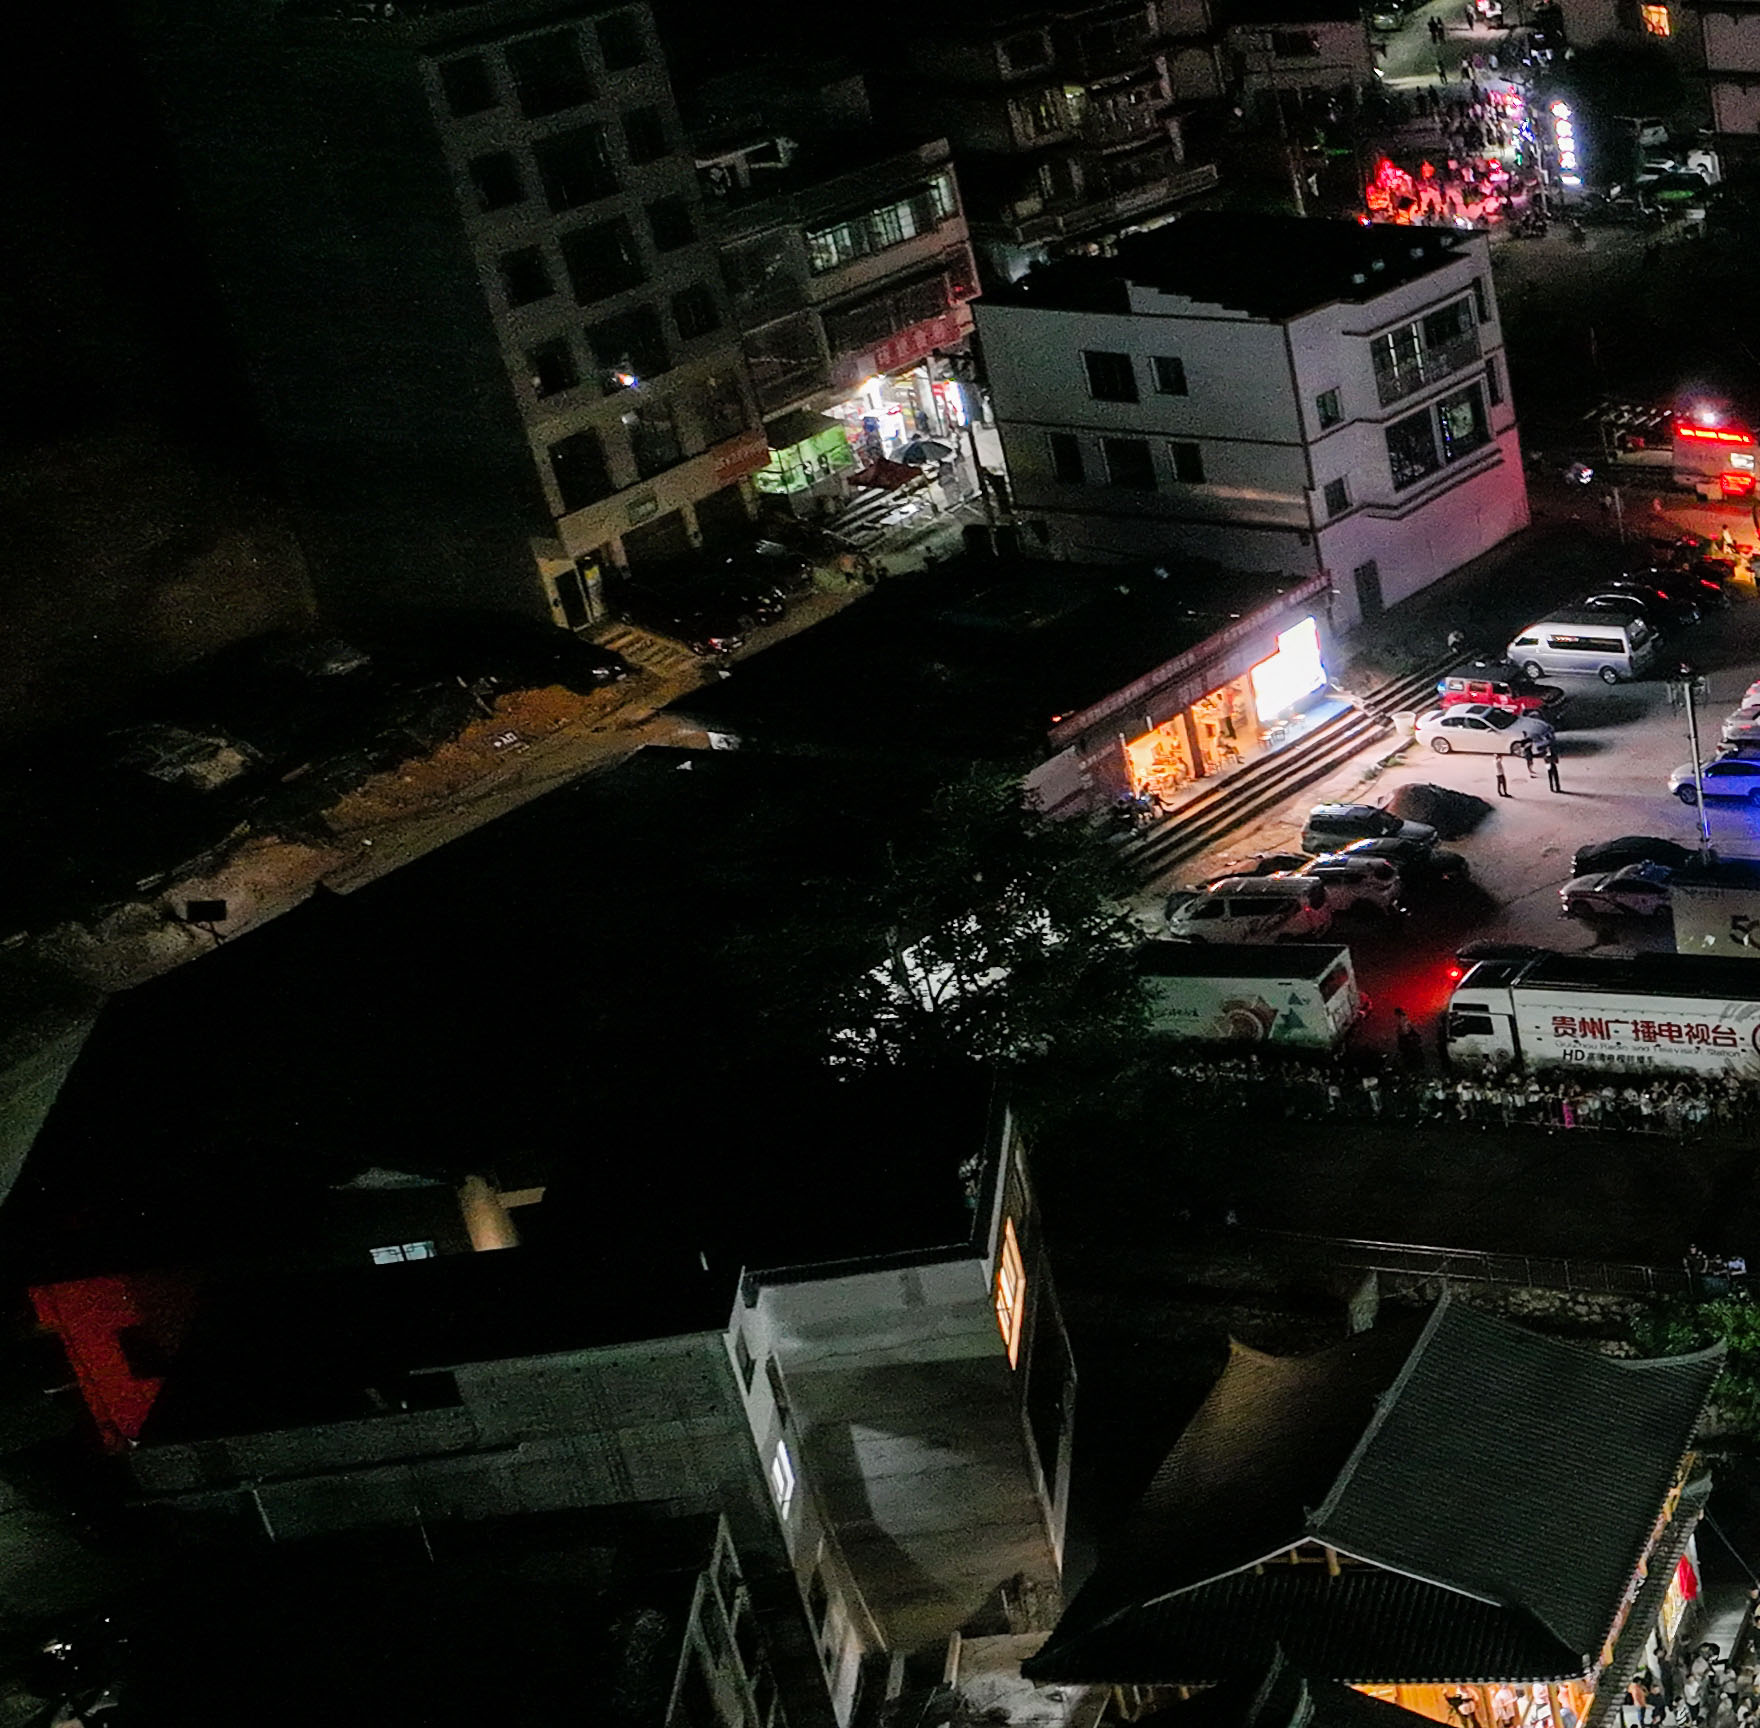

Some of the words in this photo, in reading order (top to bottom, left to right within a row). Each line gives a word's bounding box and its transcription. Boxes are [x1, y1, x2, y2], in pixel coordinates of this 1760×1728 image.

[1552, 1015, 1738, 1048] 贵州广播电视台
[1563, 1049, 1585, 1061] HD
